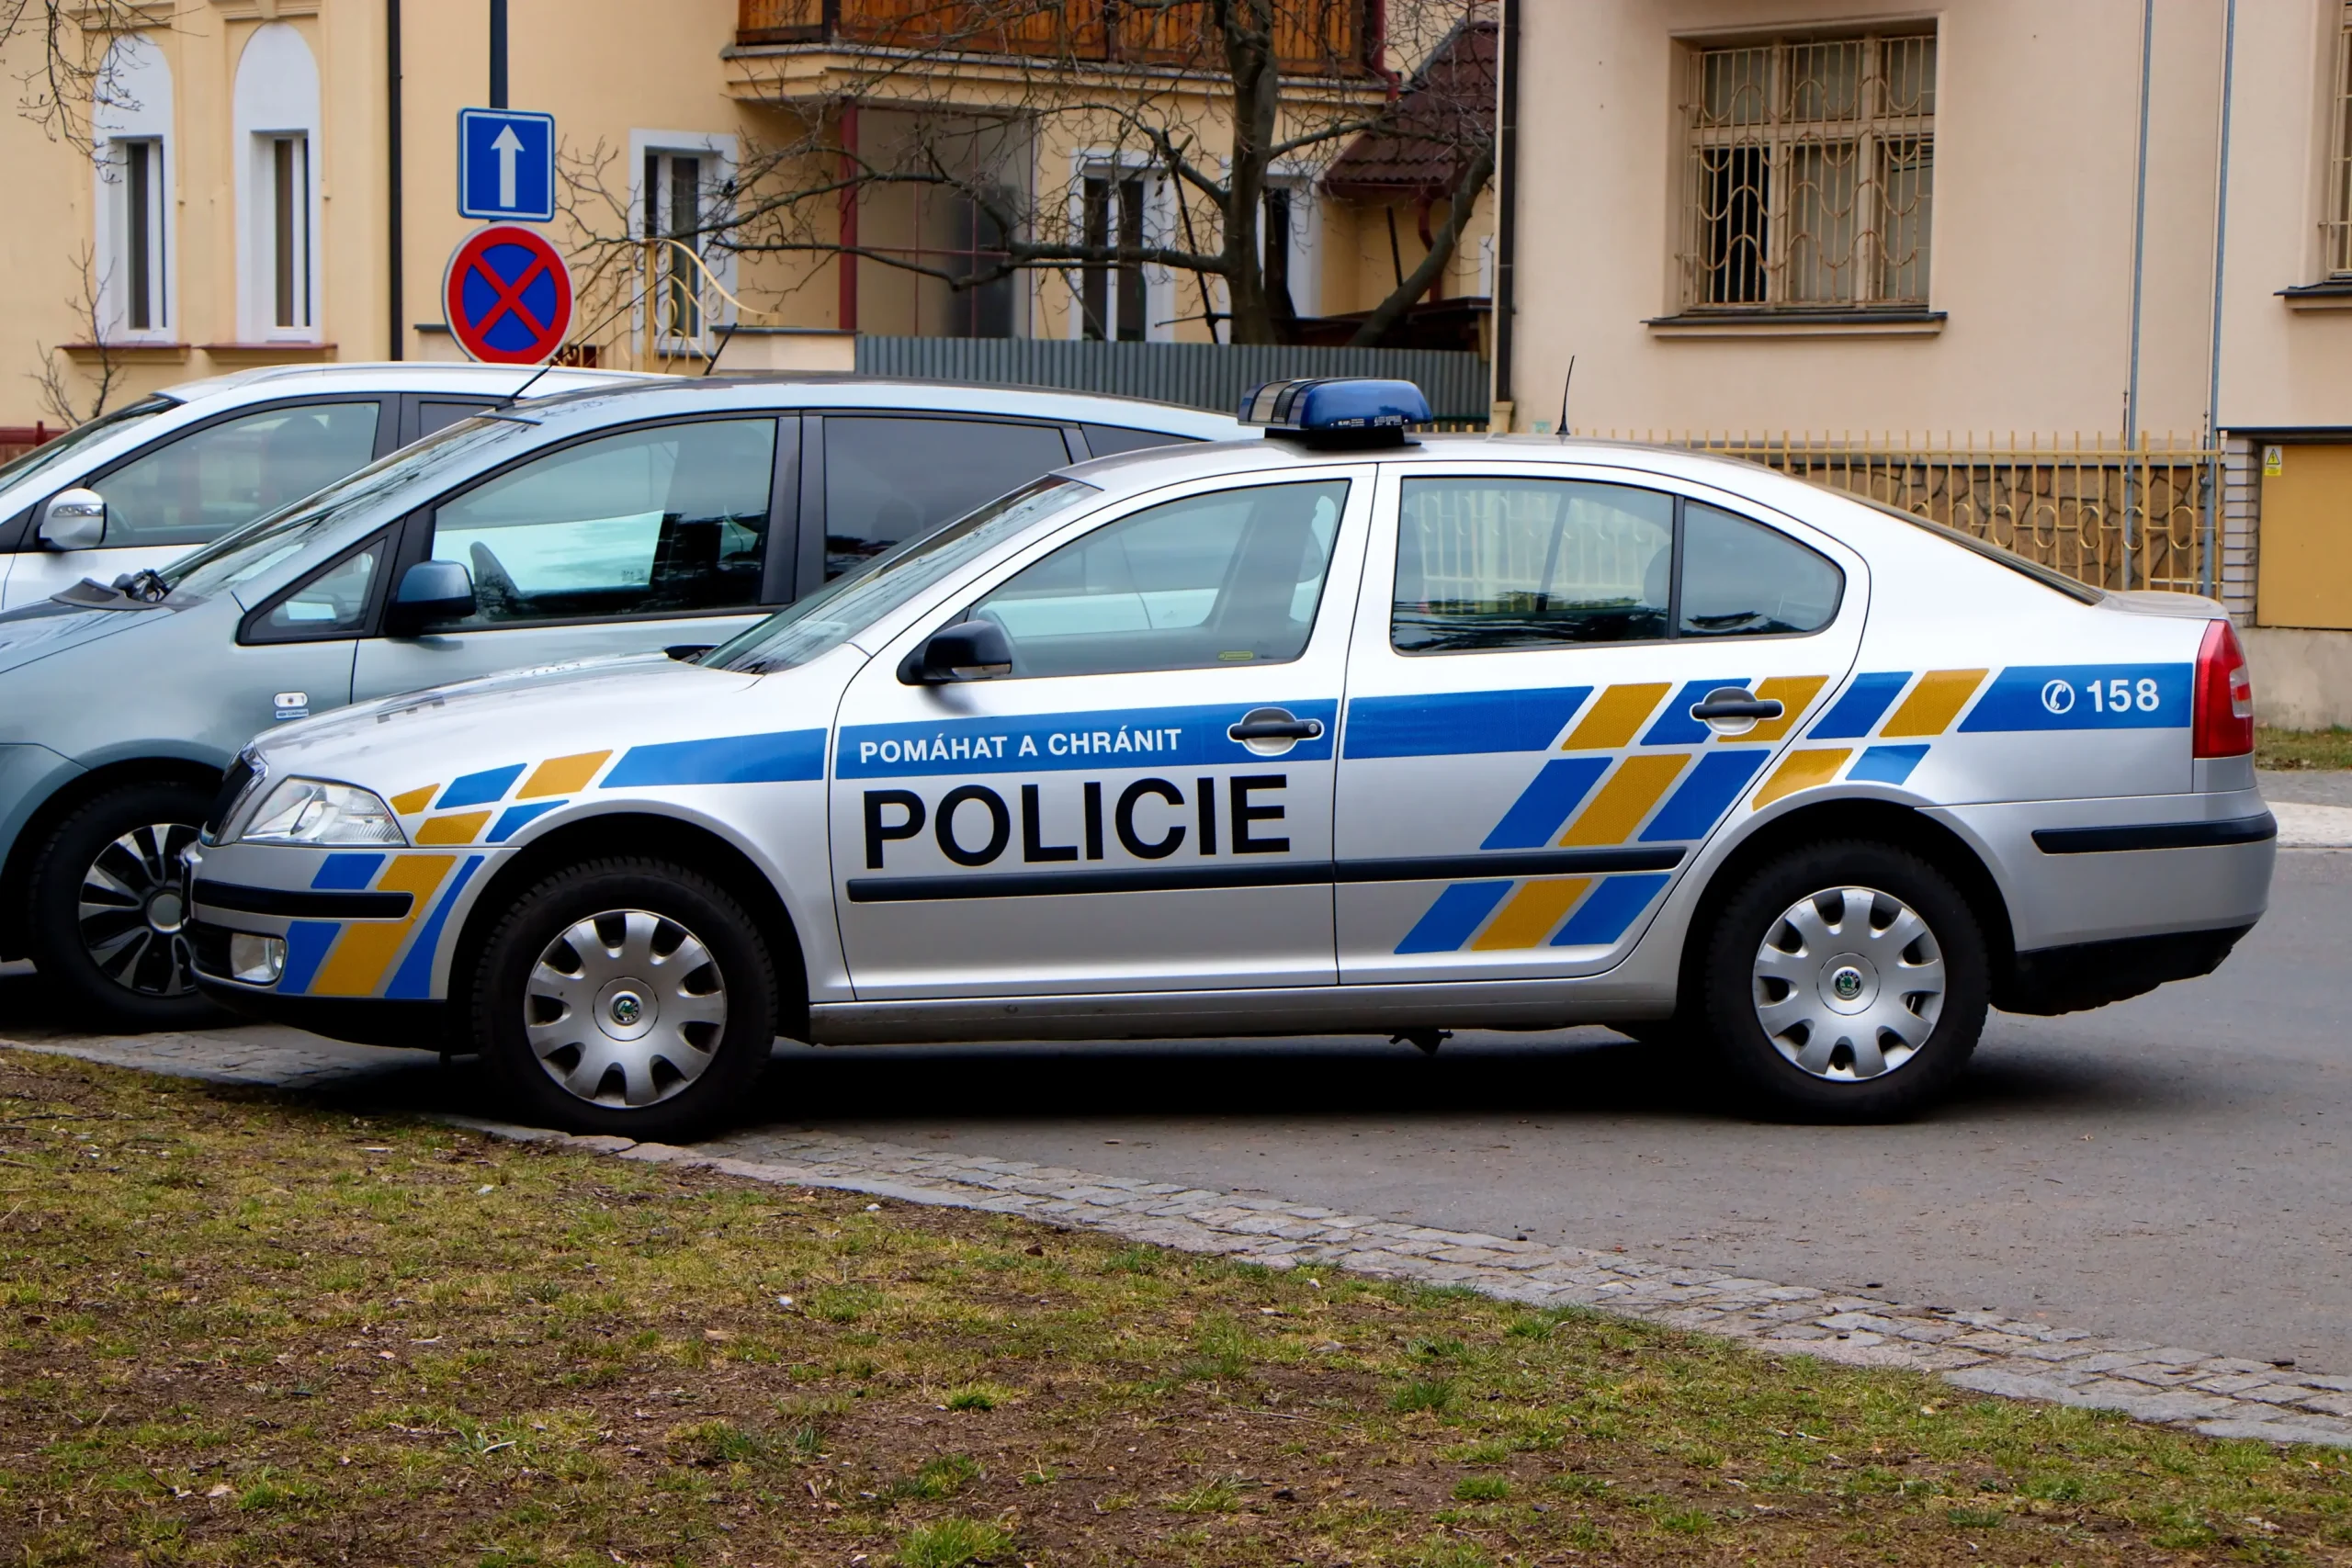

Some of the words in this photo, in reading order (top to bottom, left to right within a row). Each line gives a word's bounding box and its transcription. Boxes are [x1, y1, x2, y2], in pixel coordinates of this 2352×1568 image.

[2086, 678, 2160, 713] 158
[859, 732, 1008, 763] POMÁHAT
[1018, 735, 1038, 757] A
[1047, 725, 1182, 756] CHRÁNIT
[863, 774, 1291, 870] POLICIE
